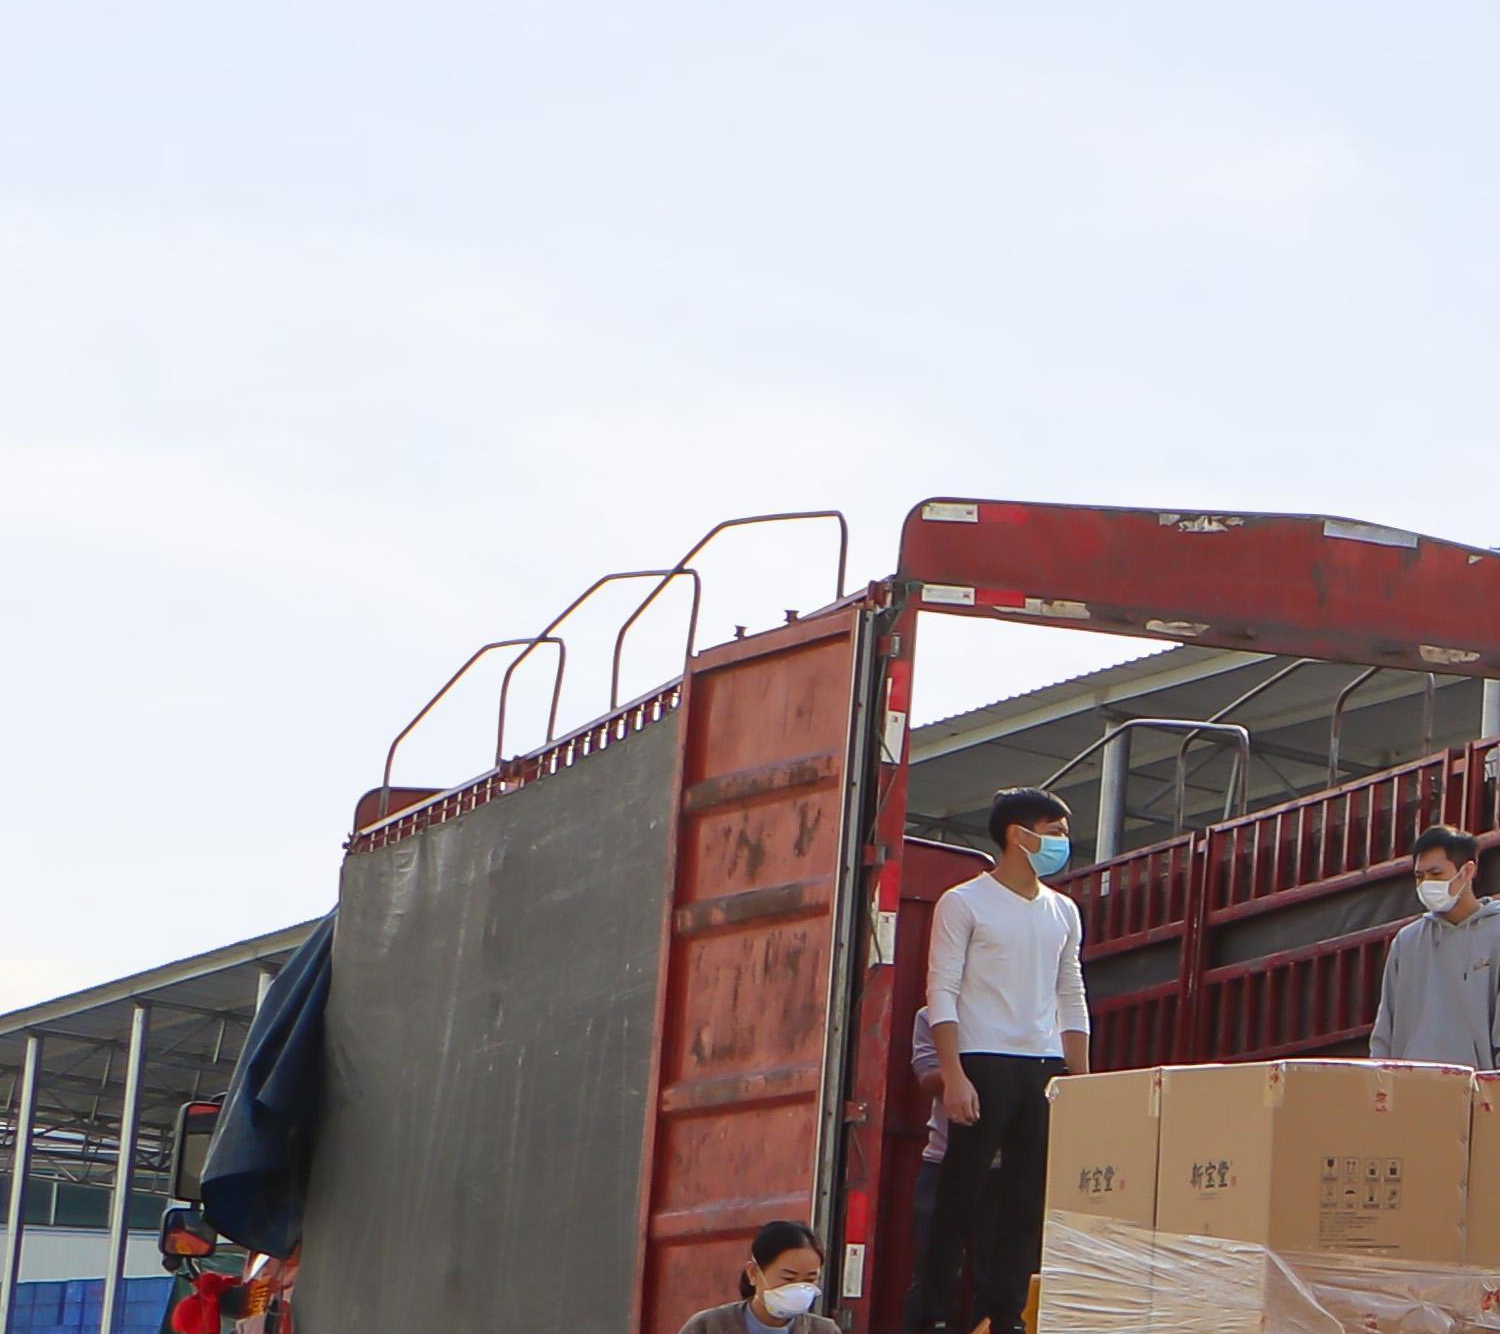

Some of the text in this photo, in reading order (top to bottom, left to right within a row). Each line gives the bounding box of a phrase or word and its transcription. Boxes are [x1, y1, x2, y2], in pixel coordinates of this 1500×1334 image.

[1079, 1165, 1115, 1194] 新宝堂
[1191, 1160, 1229, 1189] 新宝堂
